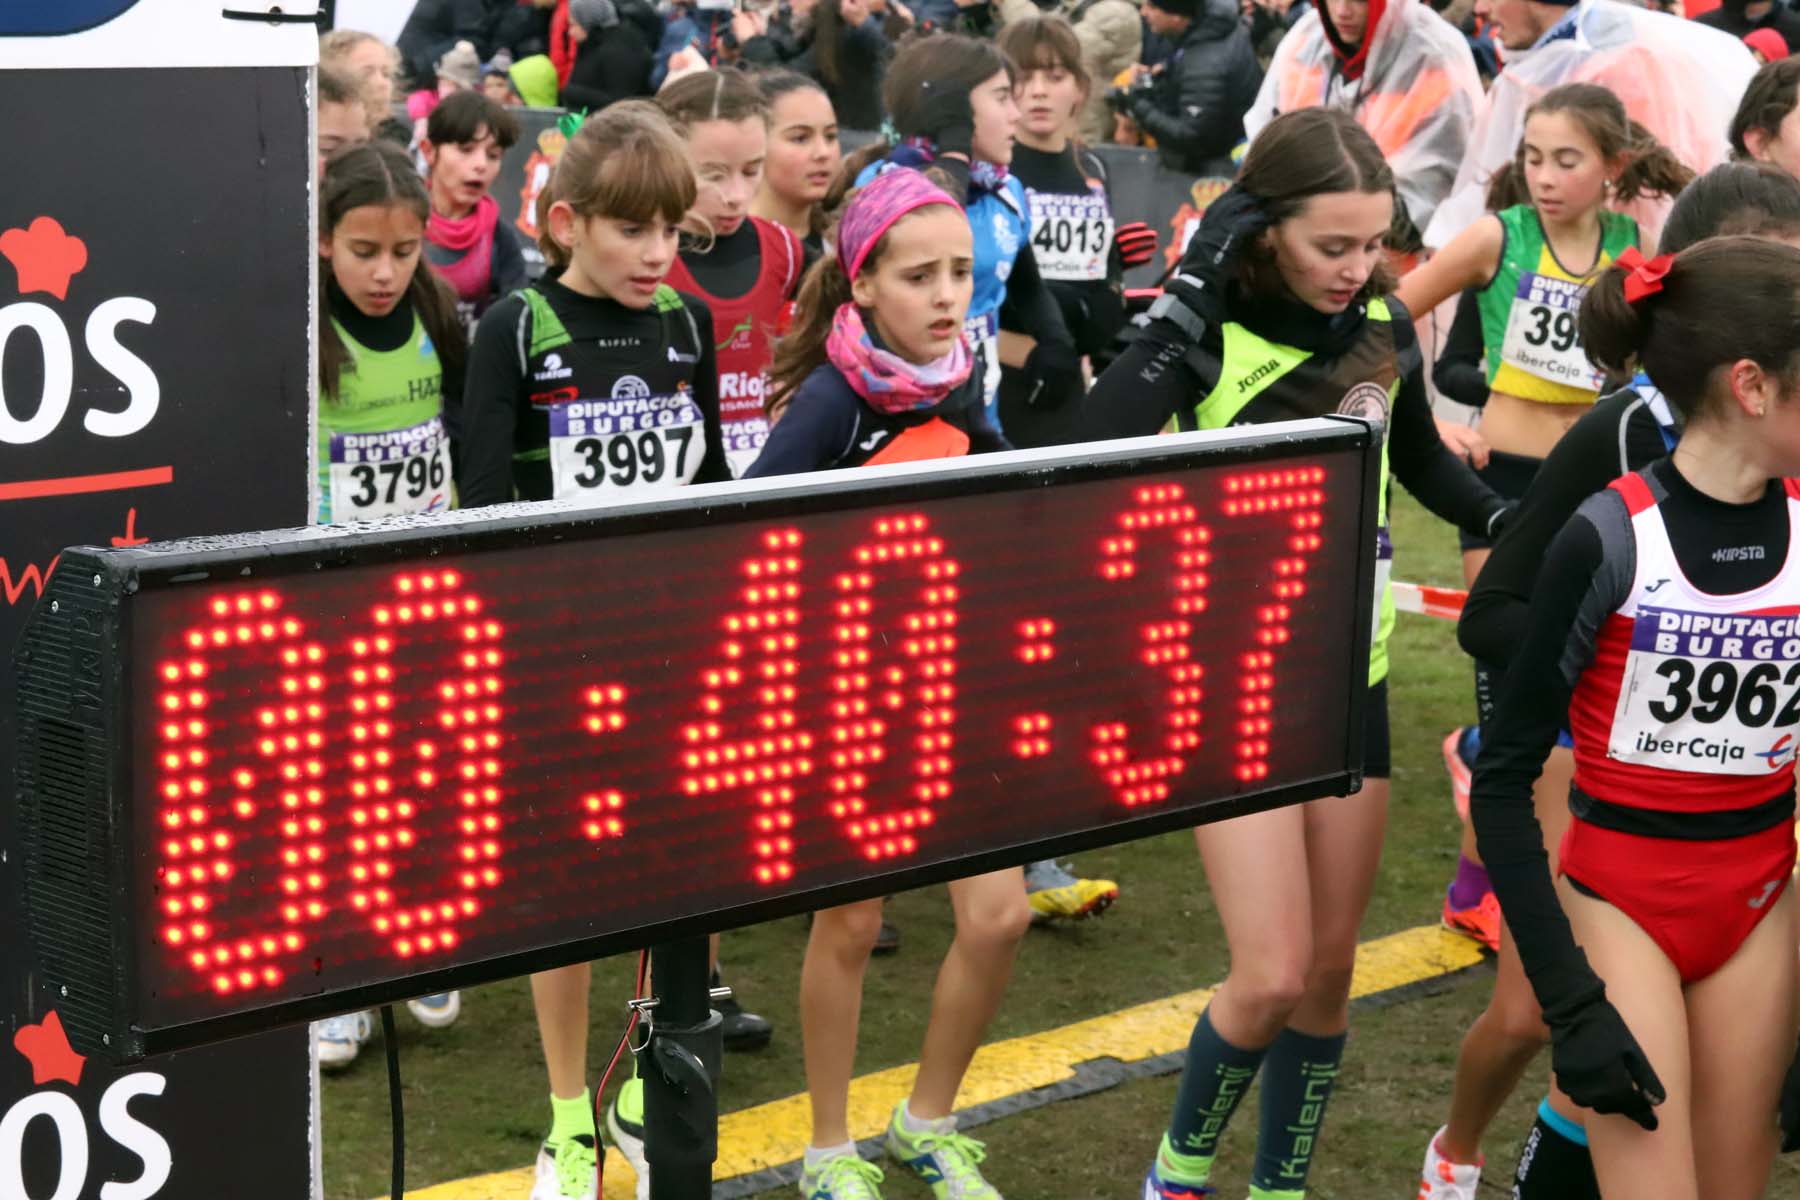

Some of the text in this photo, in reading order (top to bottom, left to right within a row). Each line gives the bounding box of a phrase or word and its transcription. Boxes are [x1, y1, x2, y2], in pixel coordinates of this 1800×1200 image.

[1034, 219, 1105, 253] 4013
[1524, 306, 1586, 352] 39
[1516, 350, 1581, 379] iberCaja
[567, 406, 695, 436] BURGOS
[574, 426, 693, 488] 3997
[350, 449, 444, 508] 3796
[1648, 658, 1800, 728] 3962
[1635, 732, 1745, 764] iberCaja
